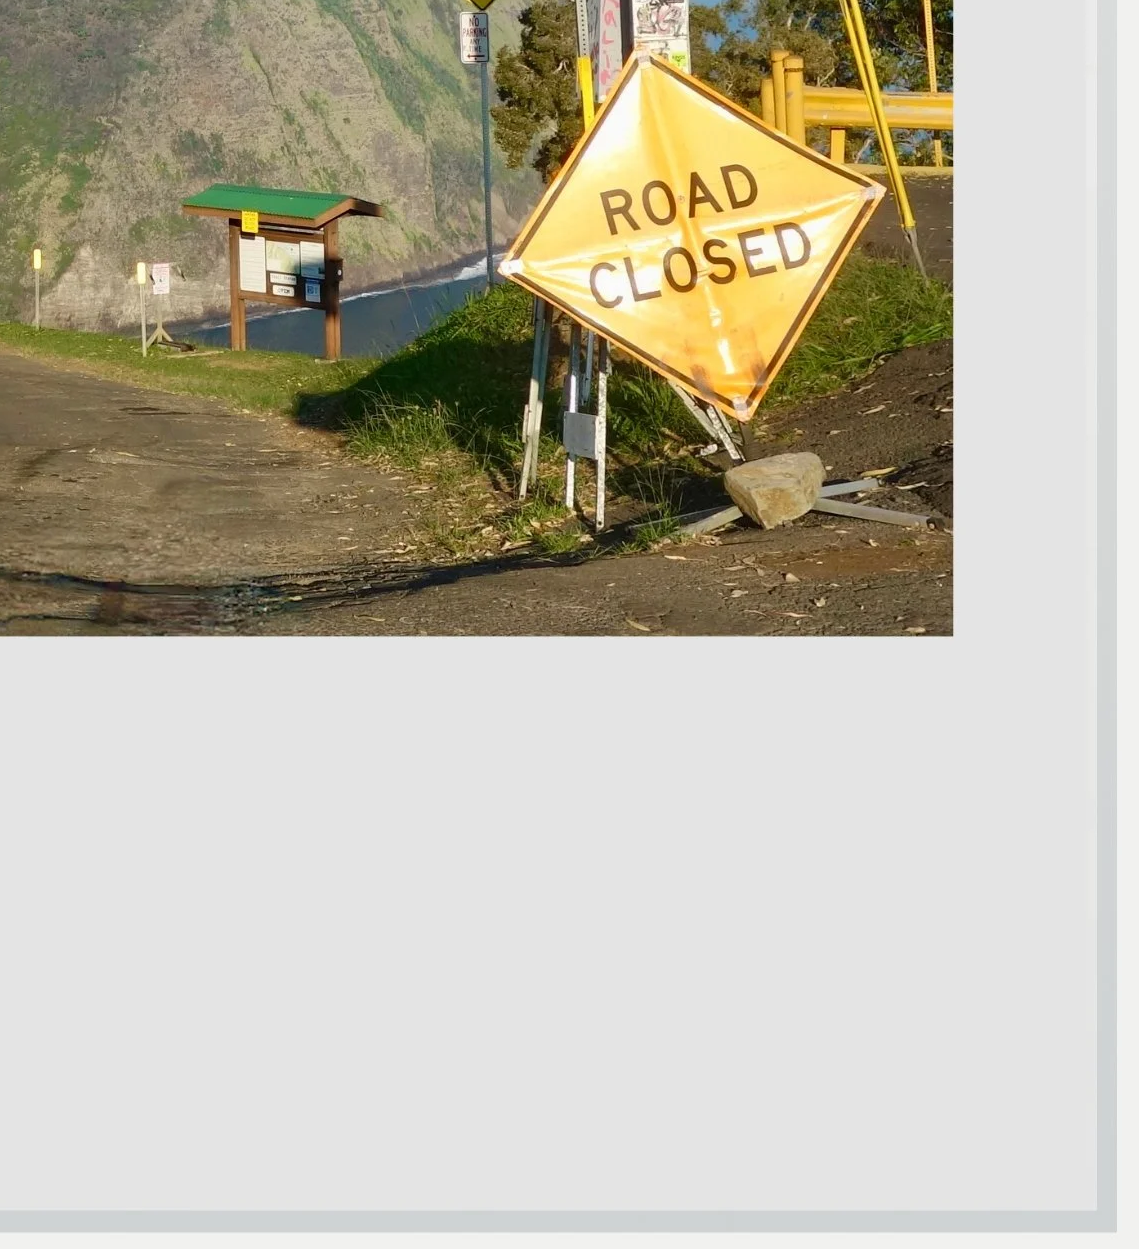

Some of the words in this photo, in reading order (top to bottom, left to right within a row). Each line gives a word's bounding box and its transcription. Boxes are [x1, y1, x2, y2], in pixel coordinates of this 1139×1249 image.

[463, 27, 487, 38] PARKING
[469, 17, 480, 27] NO
[599, 163, 758, 237] ROAD
[589, 221, 812, 310] CLOSED
